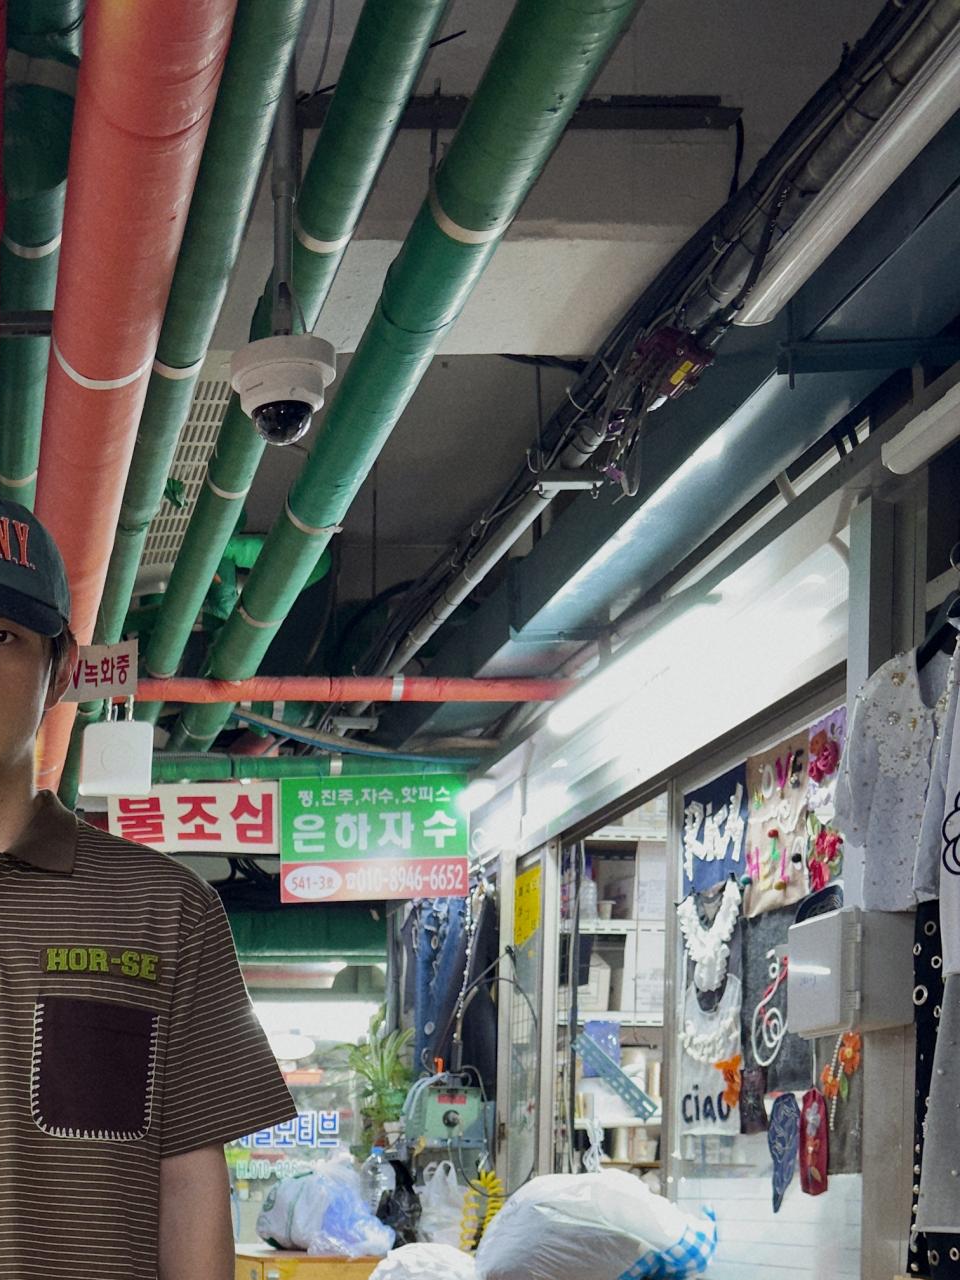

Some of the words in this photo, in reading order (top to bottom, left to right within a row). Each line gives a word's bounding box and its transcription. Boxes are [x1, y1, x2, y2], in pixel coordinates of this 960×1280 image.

[117, 794, 273, 844] 불조심
[292, 810, 457, 853] 은하자수
[46, 948, 160, 981] HOR-SE
